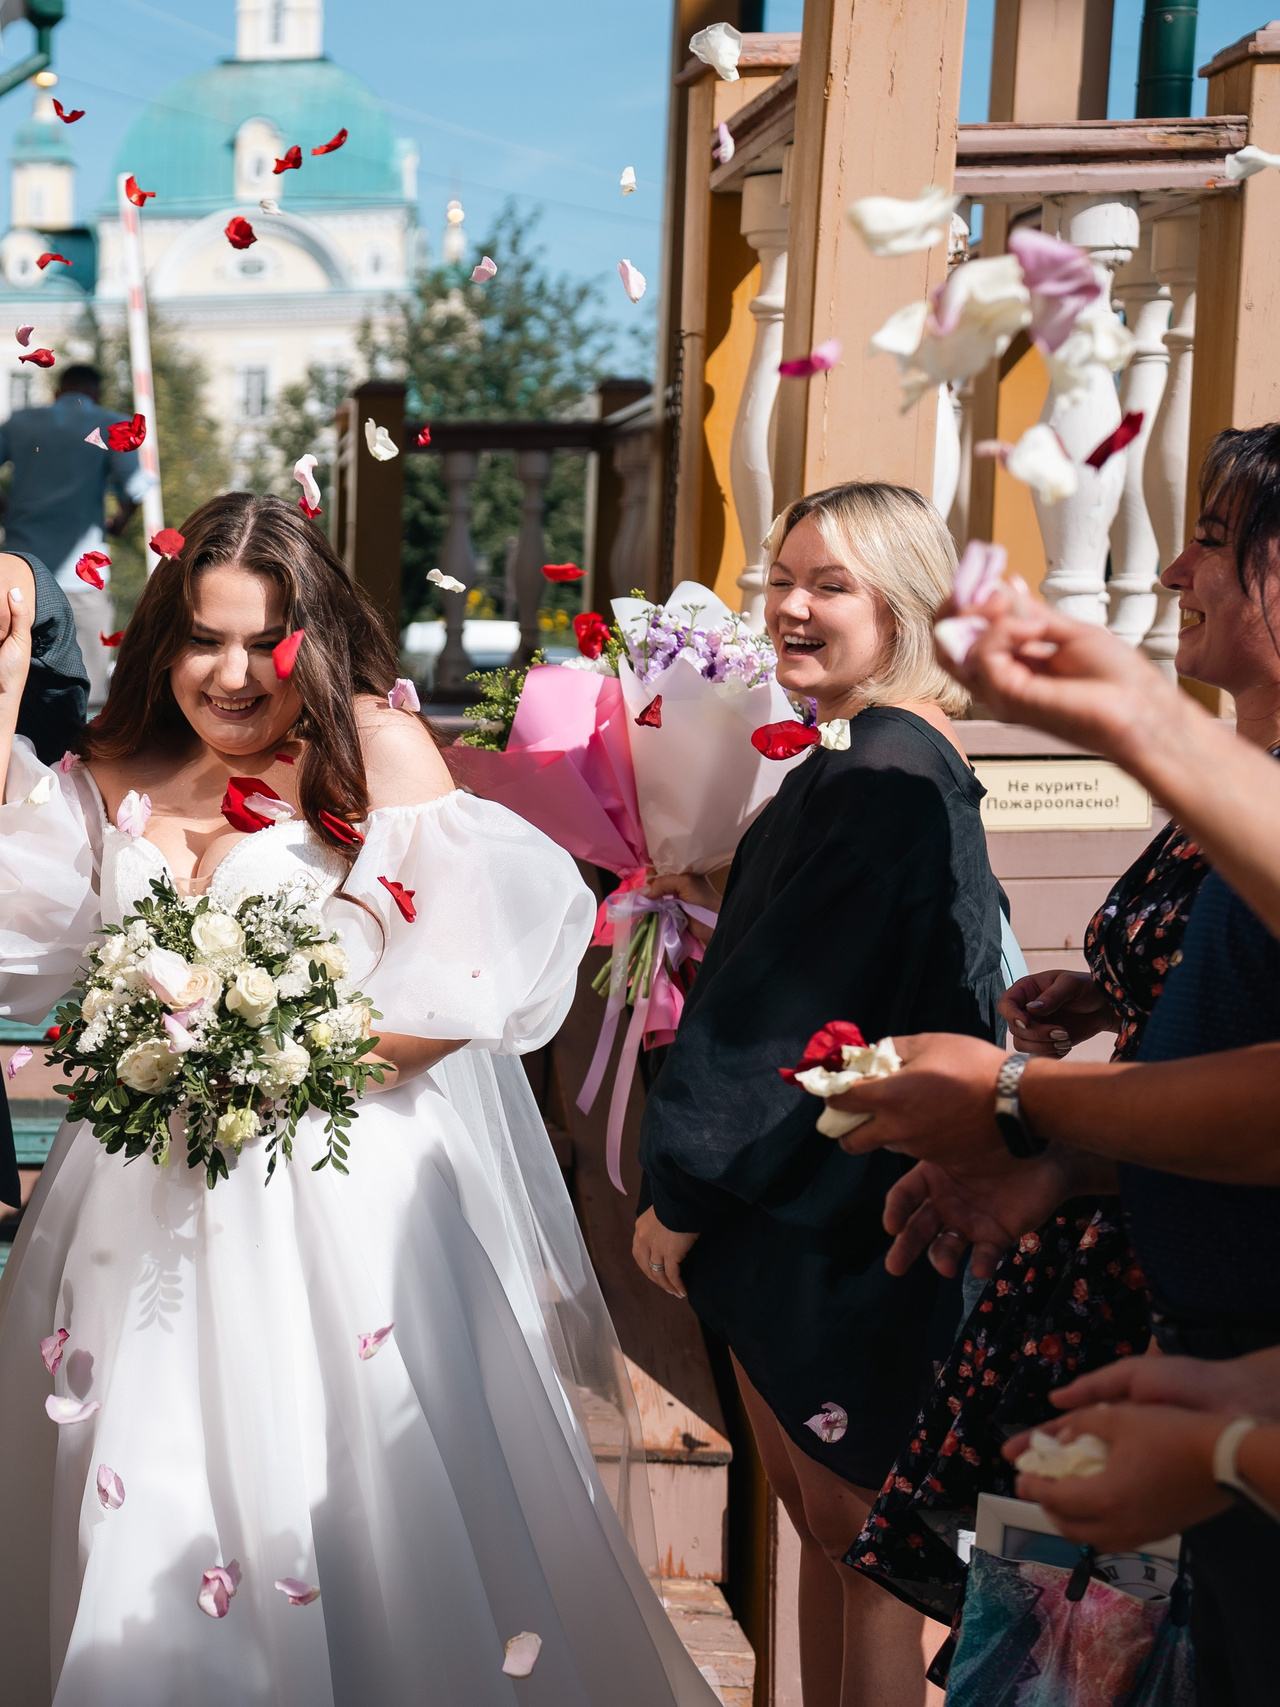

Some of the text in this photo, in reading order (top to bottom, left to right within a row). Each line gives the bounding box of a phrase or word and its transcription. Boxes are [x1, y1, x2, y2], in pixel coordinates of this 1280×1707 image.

[1008, 778, 1099, 794] Не курить!
[986, 795, 1119, 811] Пожароопасно!
